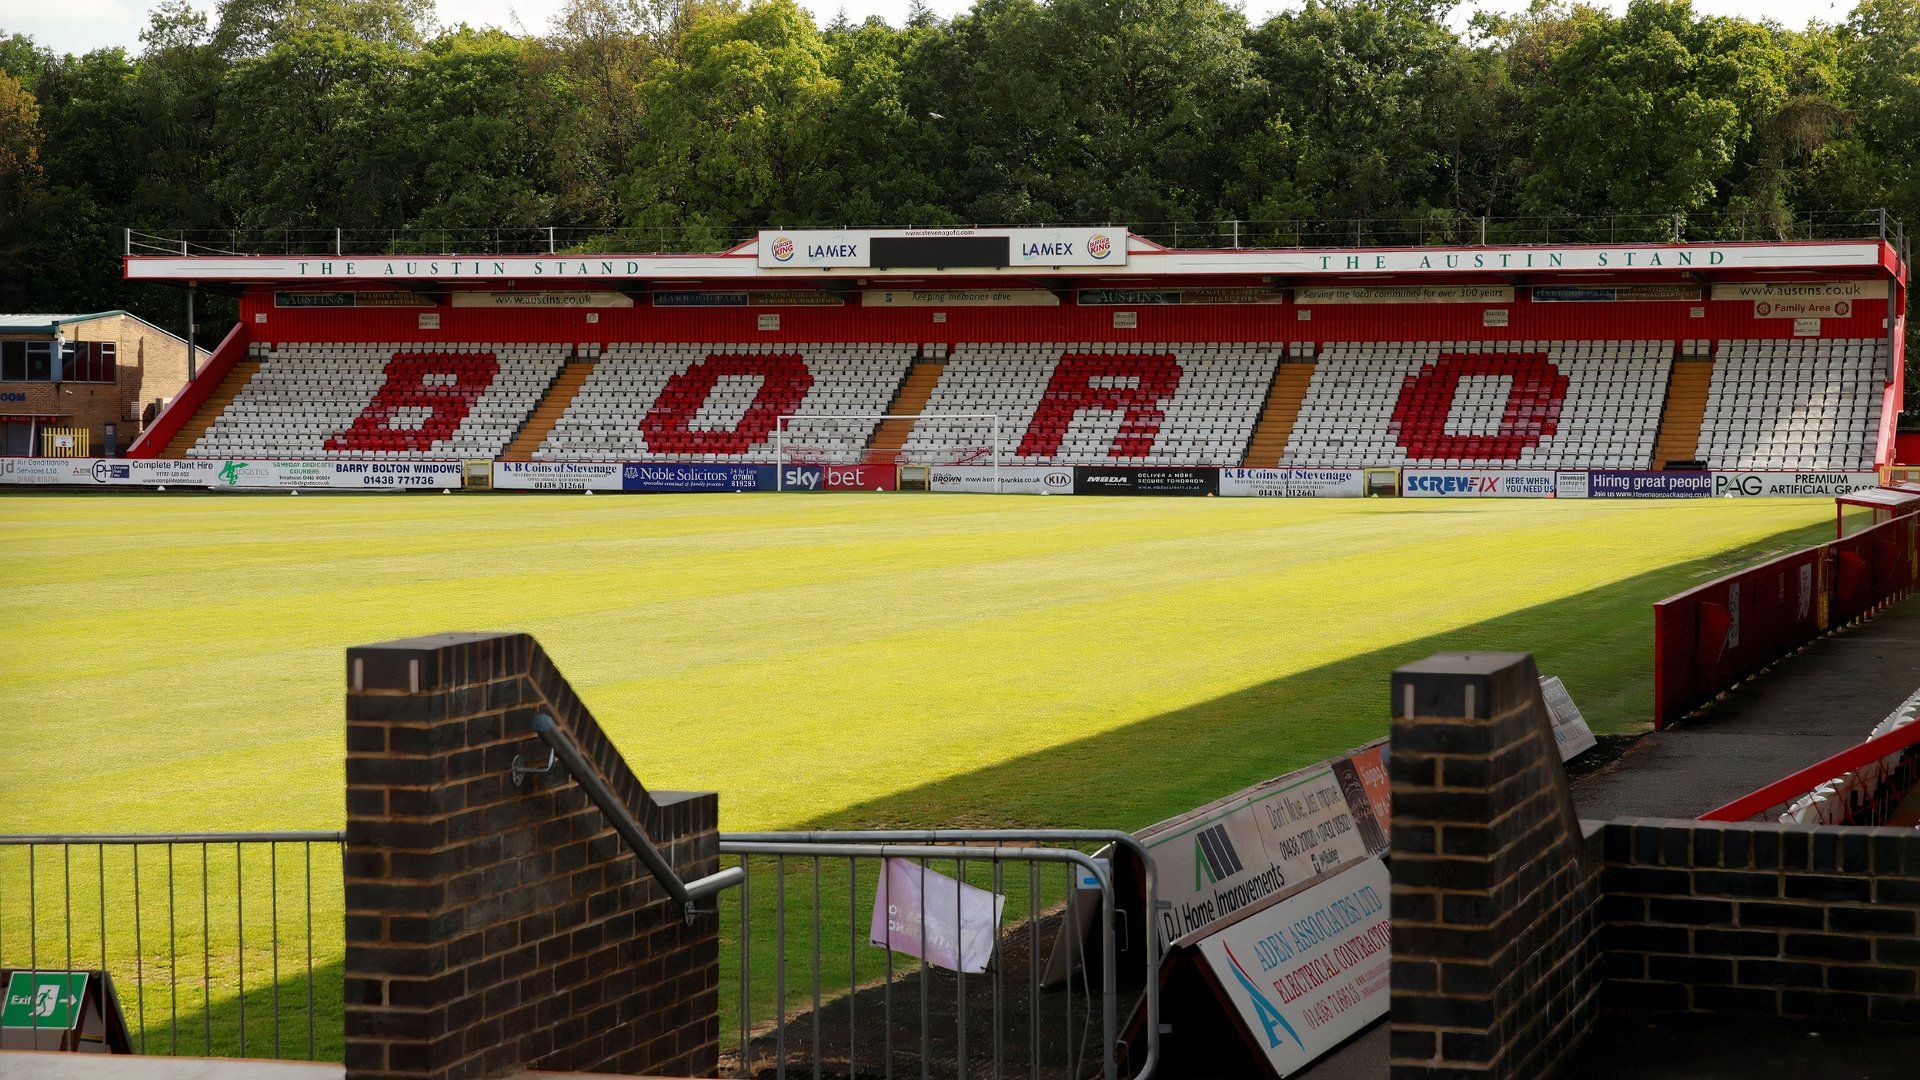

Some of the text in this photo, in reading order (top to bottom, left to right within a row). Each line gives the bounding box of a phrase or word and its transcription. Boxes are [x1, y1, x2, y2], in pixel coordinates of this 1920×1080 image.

[775, 246, 794, 257] KING
[808, 244, 858, 258] LAMEX
[1022, 243, 1073, 256] LAMEX
[1090, 243, 1110, 254] KING
[1319, 251, 1725, 270] THE AUSTIN STAND
[297, 261, 640, 276] THE AUSTIN STAND
[1303, 289, 1334, 300] Serving
[1336, 289, 1350, 299] the
[1374, 290, 1421, 300] community
[1423, 287, 1435, 299] for
[1438, 289, 1456, 298] over
[1459, 287, 1478, 297] 300
[1479, 289, 1504, 299] years
[1739, 283, 1861, 297] www.austins.co.uk
[911, 292, 1012, 304] Keeping memories alive
[1775, 303, 1832, 315] Family Area
[0, 459, 15, 478] jd
[28, 459, 69, 468] Conditioning
[132, 461, 214, 471] Complete Plant Hire
[336, 463, 461, 474] BARRY BOLTON WINDOWS
[504, 462, 512, 472] K
[514, 462, 523, 472] B
[524, 462, 552, 473] Coins
[554, 462, 566, 473] of
[566, 463, 618, 476] Stevenage
[237, 468, 270, 476] LOGISTICS
[640, 467, 728, 481] Noble Solicitors
[786, 466, 865, 490] sky bet
[1224, 469, 1353, 482] K B Coins of Stevenage
[363, 475, 434, 485] 01438 771736
[1048, 476, 1067, 484] KIA
[1407, 475, 1501, 495] SCREWFIX
[1505, 477, 1550, 485] HERE WHEN
[1593, 474, 1712, 491] Hiring great people
[1716, 475, 1763, 496] PAG
[1795, 474, 1848, 484] PREMIUM
[1258, 489, 1316, 497] 01438 312661
[1505, 485, 1520, 493] YOU
[1520, 485, 1543, 493] NEED
[1544, 485, 1555, 493] US
[1593, 490, 1607, 498] Join
[1769, 485, 1831, 494] ARTIFICIAL
[1181, 899, 1216, 935] Home
[1213, 862, 1286, 918] Improvements
[1253, 886, 1384, 973] ADEN ASSOCIATES LTD
[1272, 953, 1342, 1005] ELECTRICAL
